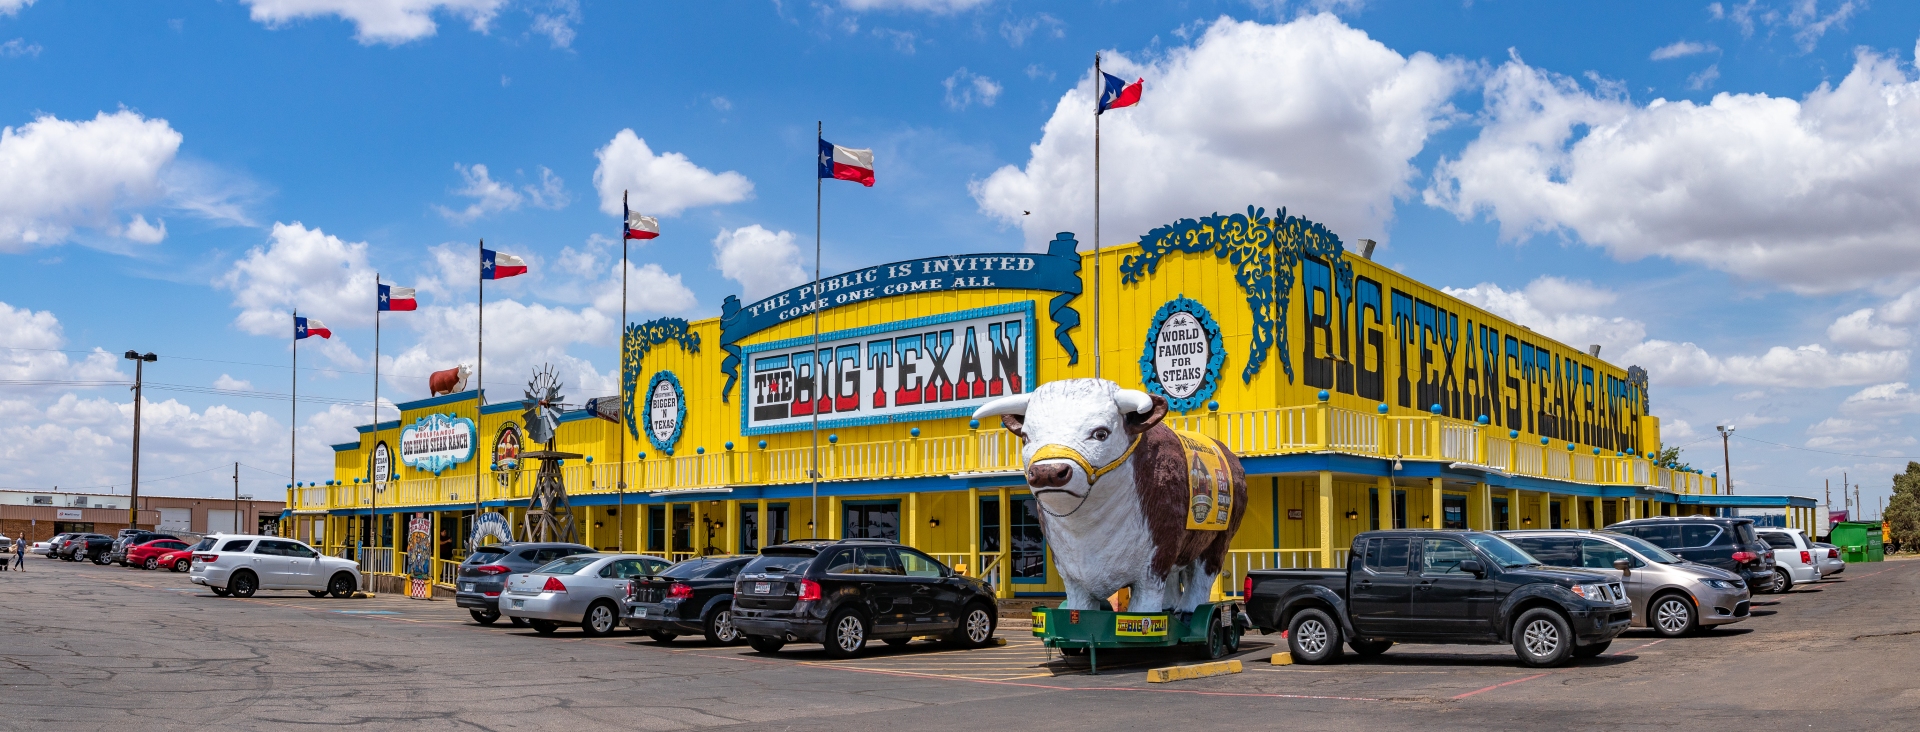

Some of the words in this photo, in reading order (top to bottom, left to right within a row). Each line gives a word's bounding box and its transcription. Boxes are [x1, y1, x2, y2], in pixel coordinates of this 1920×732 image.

[748, 292, 790, 318] THE
[797, 268, 877, 301] PUBLIC
[887, 263, 912, 279] IS
[921, 256, 1035, 275] INVITED
[779, 297, 829, 320] COME
[835, 287, 875, 304] ONE
[883, 278, 943, 295] COME
[950, 276, 996, 288] ALL
[1161, 328, 1199, 343] WORLD
[1158, 341, 1204, 358] FAMOUS
[1302, 252, 1385, 403] BIG
[1390, 286, 1503, 428] TEXAN
[1504, 333, 1581, 444] STEAK
[1581, 363, 1639, 456] RANCH
[754, 370, 793, 405] THE
[790, 342, 861, 418] BIG
[867, 319, 1022, 409] TEXAN
[1171, 357, 1191, 367] FOR
[1162, 367, 1201, 382] STEAKS
[652, 397, 676, 409] BIGGER
[653, 418, 675, 430] TEXAS
[430, 436, 448, 453] STEAK
[448, 432, 468, 451] RANCH
[1127, 619, 1142, 632] BIG
